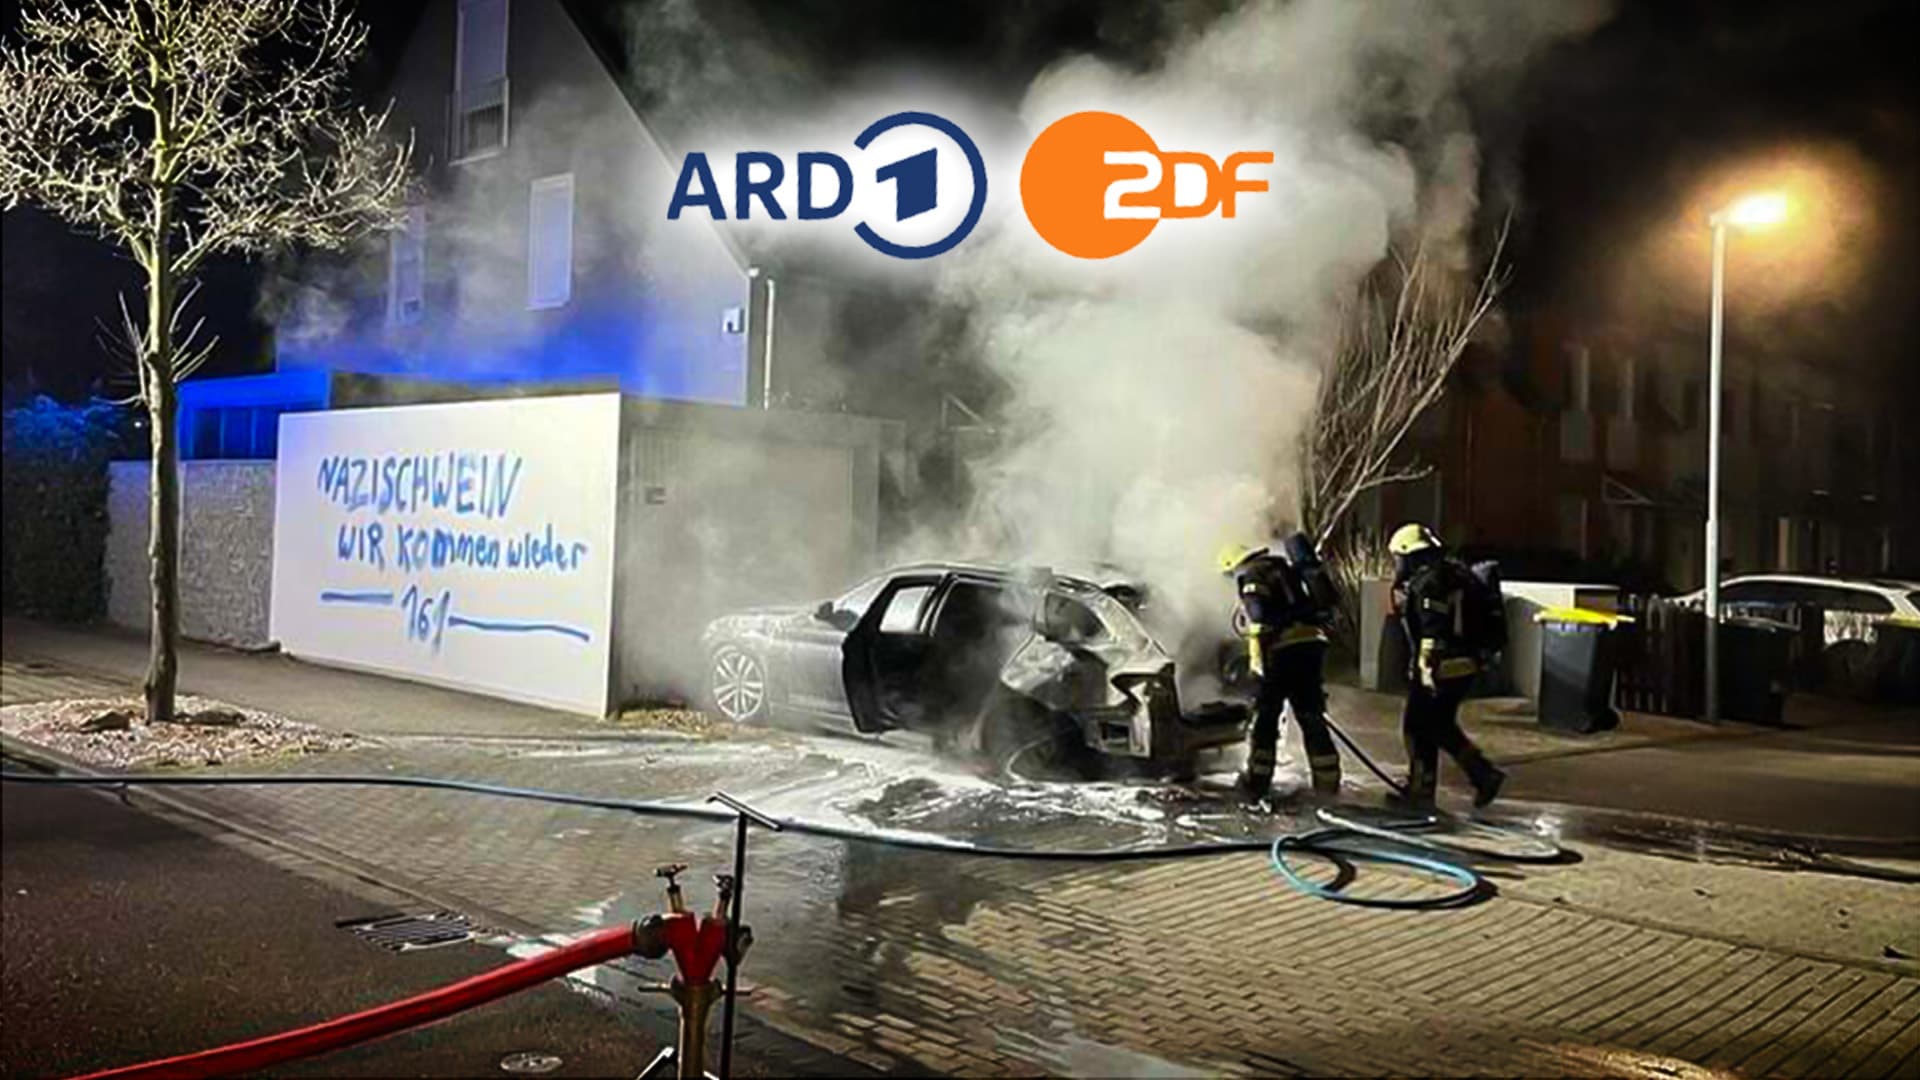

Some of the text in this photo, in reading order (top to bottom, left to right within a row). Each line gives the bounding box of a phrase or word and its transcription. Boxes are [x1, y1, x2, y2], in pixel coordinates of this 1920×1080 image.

[317, 453, 523, 518] NAZISCHWEIN
[337, 522, 385, 571] WIR
[401, 585, 450, 651] 161
